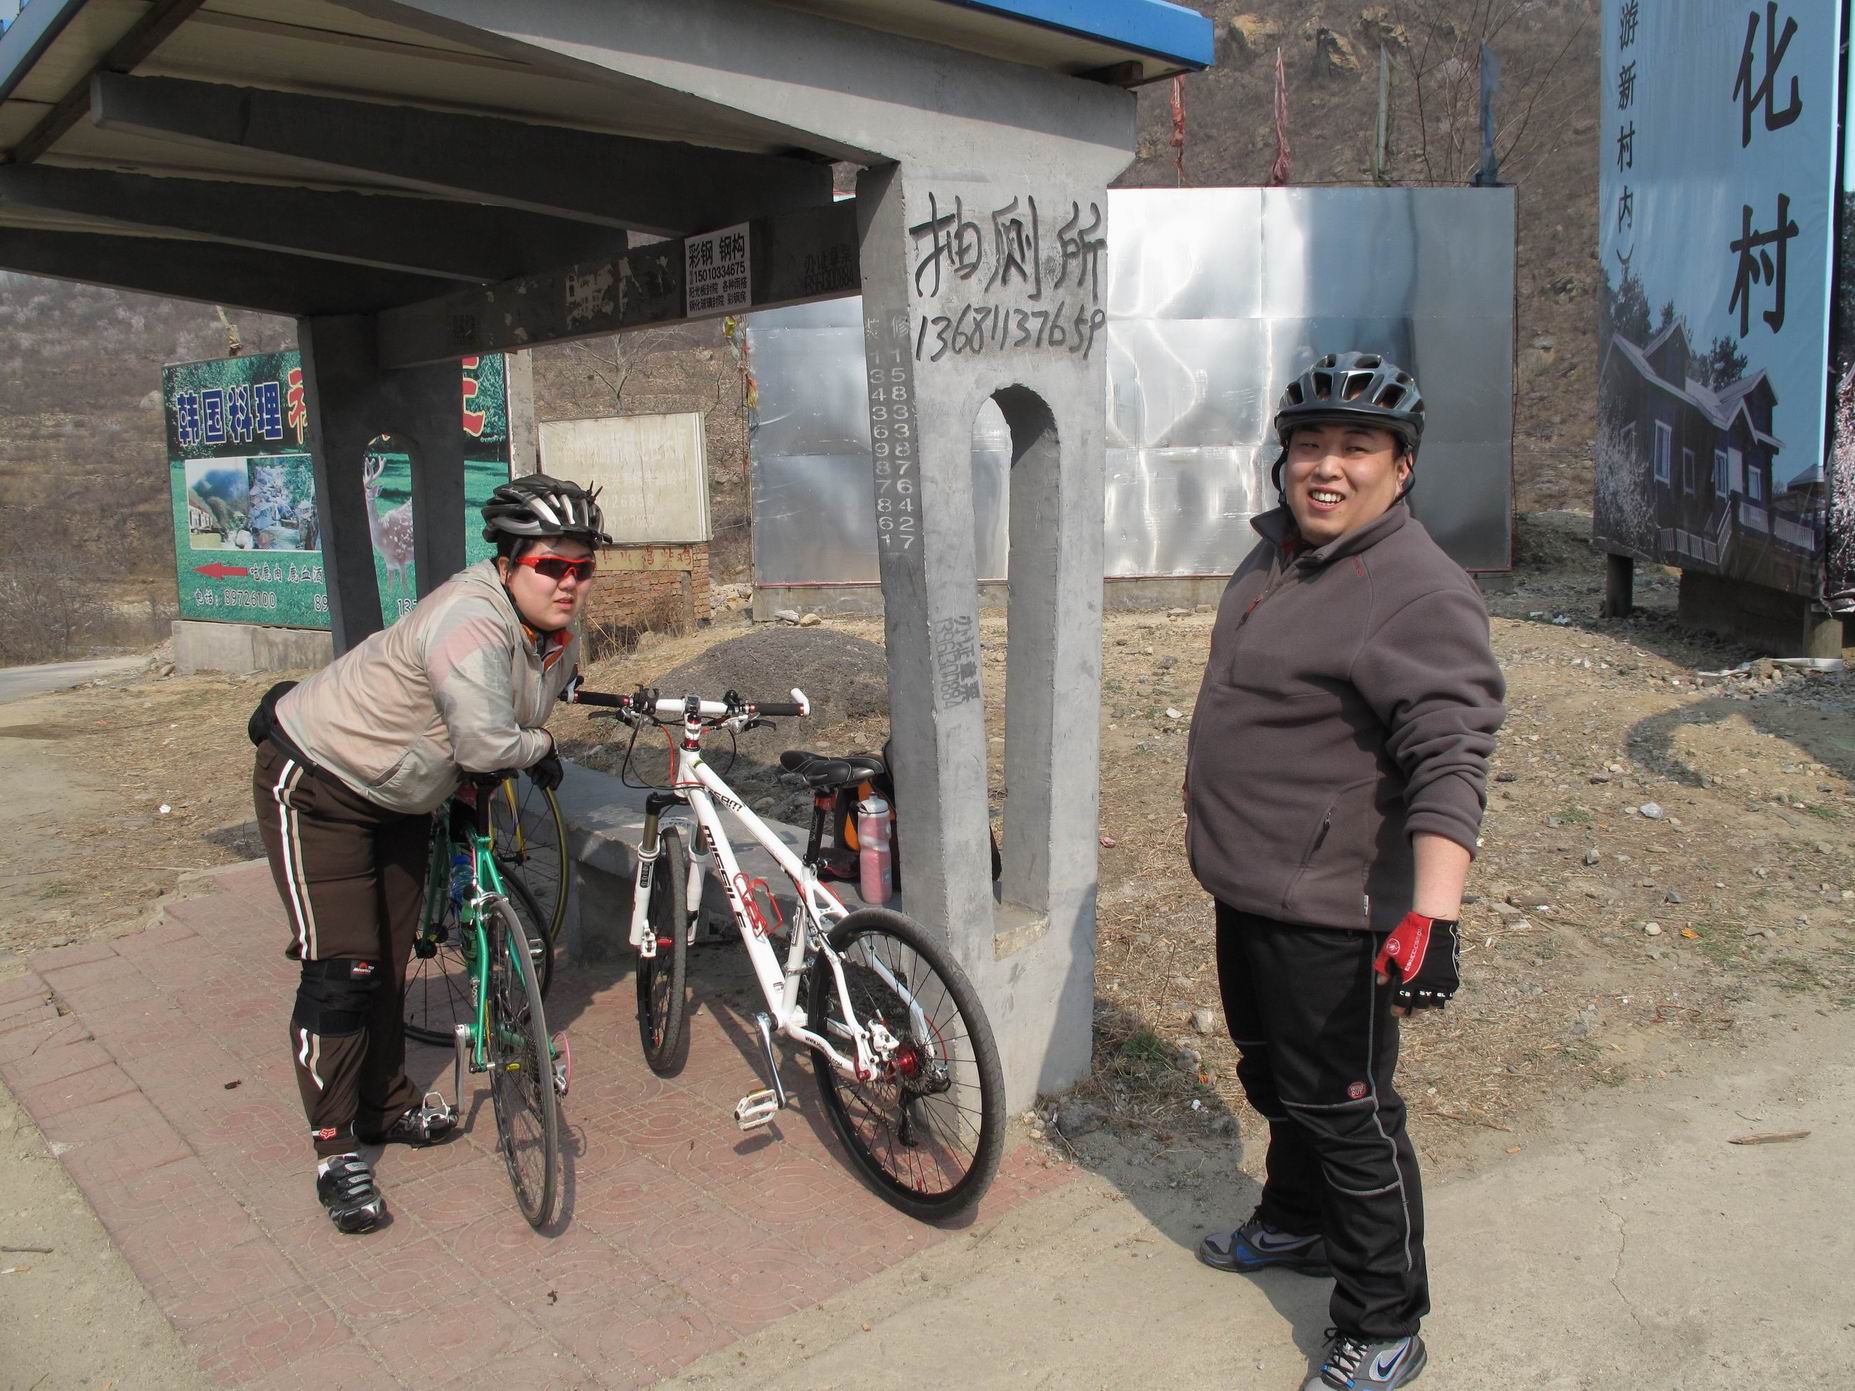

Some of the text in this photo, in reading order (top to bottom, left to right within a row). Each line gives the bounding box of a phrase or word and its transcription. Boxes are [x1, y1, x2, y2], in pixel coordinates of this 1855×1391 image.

[1729, 1, 1802, 338] 化村
[688, 233, 745, 269] 彩钢 钢构
[694, 261, 746, 283] 15010334675
[915, 301, 1106, 361] 13681137659
[176, 381, 283, 446] 韩国料理
[224, 588, 277, 608] 89726100
